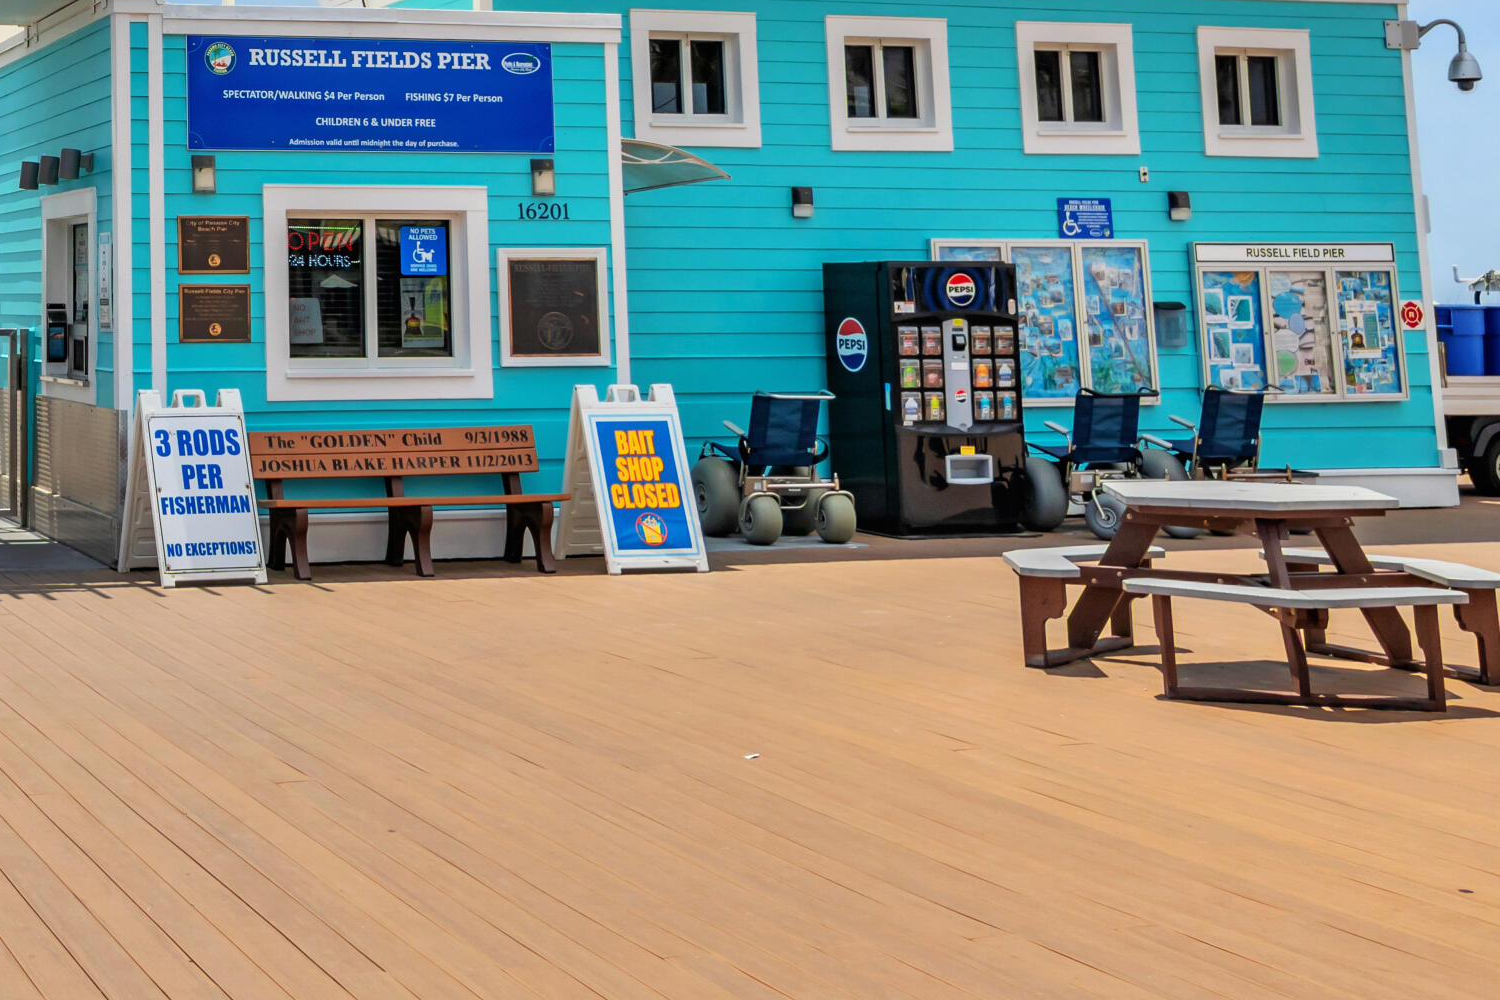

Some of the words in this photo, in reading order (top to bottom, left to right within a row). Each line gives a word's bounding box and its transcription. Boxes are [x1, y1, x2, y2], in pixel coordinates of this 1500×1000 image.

[249, 48, 346, 67] RUSSELL
[351, 50, 432, 69] FIELDS
[437, 52, 491, 70] PIER
[222, 89, 322, 100] SPECTATOR/WALKING
[324, 90, 335, 101] $4
[337, 91, 352, 100] Per
[354, 92, 385, 101] Person
[405, 93, 441, 102] FISHING
[444, 92, 454, 103] $7
[456, 94, 471, 102] Per
[473, 94, 503, 103] Person
[316, 117, 361, 126] CHILDREN
[363, 118, 369, 126] 6
[371, 118, 378, 127] &
[381, 118, 413, 127] UNDER
[415, 119, 436, 127] FREE
[289, 138, 324, 146] Admission
[326, 138, 343, 146] valid
[361, 139, 391, 148] midnight
[405, 139, 417, 148] day
[418, 139, 426, 147] of
[427, 140, 459, 148] purchase.
[518, 203, 570, 220] 16201
[288, 232, 353, 251] OPEN
[289, 254, 304, 267] 24
[308, 254, 351, 267] HOURS
[1247, 248, 1290, 257] RUSSELL
[1293, 248, 1320, 257] FIELD
[1323, 248, 1345, 258] PIER
[839, 338, 865, 350] PEPSI
[154, 430, 171, 457] 3
[176, 429, 240, 456] RODS
[264, 435, 295, 449] The
[301, 433, 395, 449] "GOLDEN"
[402, 432, 442, 447] Child
[464, 429, 529, 445] 9/3/1988
[614, 430, 655, 455] BAIT
[259, 457, 327, 473] JOSHUA
[332, 456, 387, 472] BLAKE
[392, 455, 461, 470] HARPER
[466, 453, 532, 468] 11/2/2013
[615, 456, 664, 482] SHOP
[181, 464, 223, 490] PER
[161, 495, 250, 515] FISHERMAN
[610, 483, 680, 509] CLOSED
[166, 543, 183, 557] NO
[186, 541, 257, 557] EXCEPTIONS!
